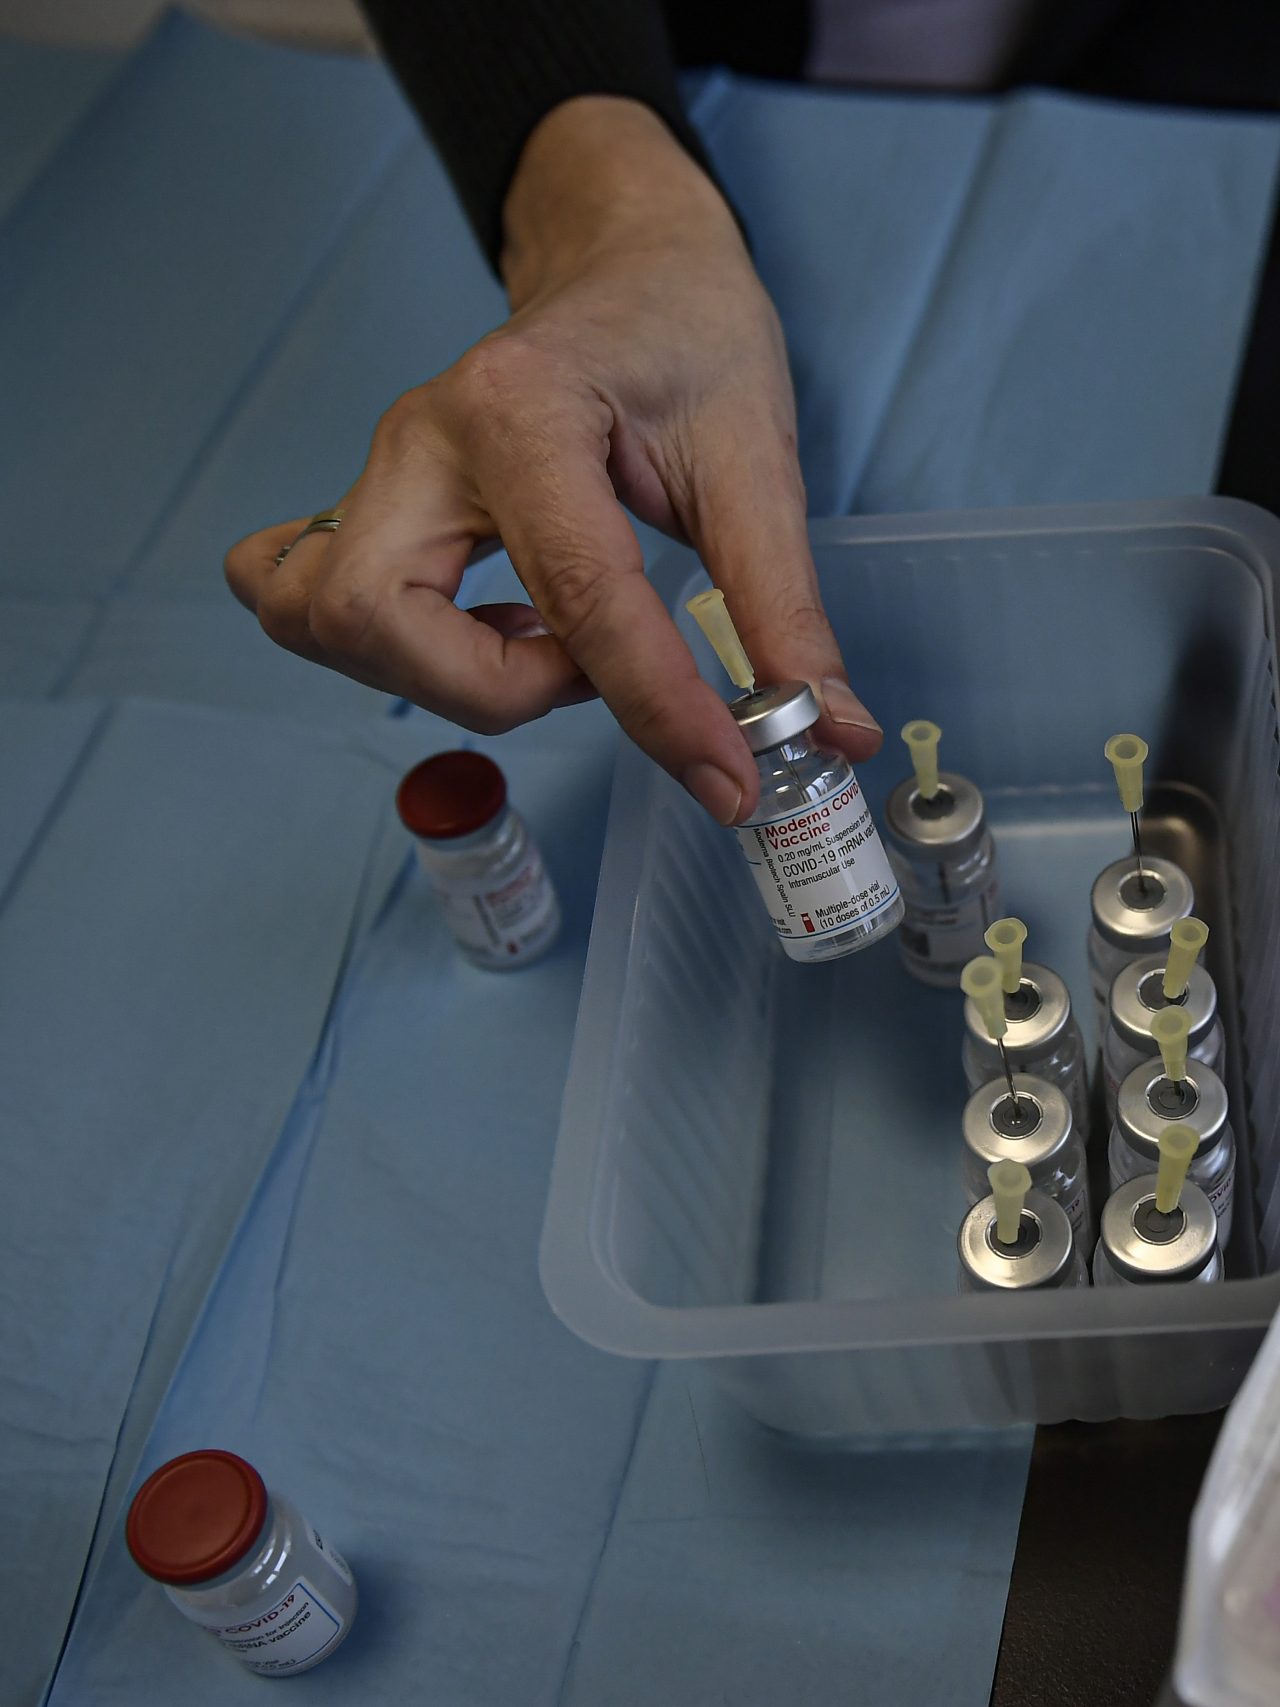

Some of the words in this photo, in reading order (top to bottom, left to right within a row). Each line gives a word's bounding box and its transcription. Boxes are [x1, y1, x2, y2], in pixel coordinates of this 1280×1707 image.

[764, 806, 831, 838] Moderna
[768, 821, 831, 850] Vaccine
[777, 851, 796, 863] 0.20
[797, 841, 826, 857] mg/mL
[826, 820, 861, 846] Suspension
[782, 849, 837, 877] COVID-19
[838, 831, 866, 858] mRNA
[753, 827, 770, 858] Moderna
[766, 858, 781, 883] Biotech
[777, 884, 789, 903] Spain
[785, 904, 796, 918] SLU
[788, 866, 841, 890] Intramuscular
[841, 857, 855, 870] Use
[815, 889, 870, 919] Multiple-dose
[868, 880, 881, 894] vial
[819, 917, 835, 930] (10
[835, 907, 860, 924] doses
[860, 901, 870, 912] of
[868, 894, 881, 908] 0.5
[225, 1594, 295, 1634] COVID-19
[269, 1611, 312, 1643] vaccine
